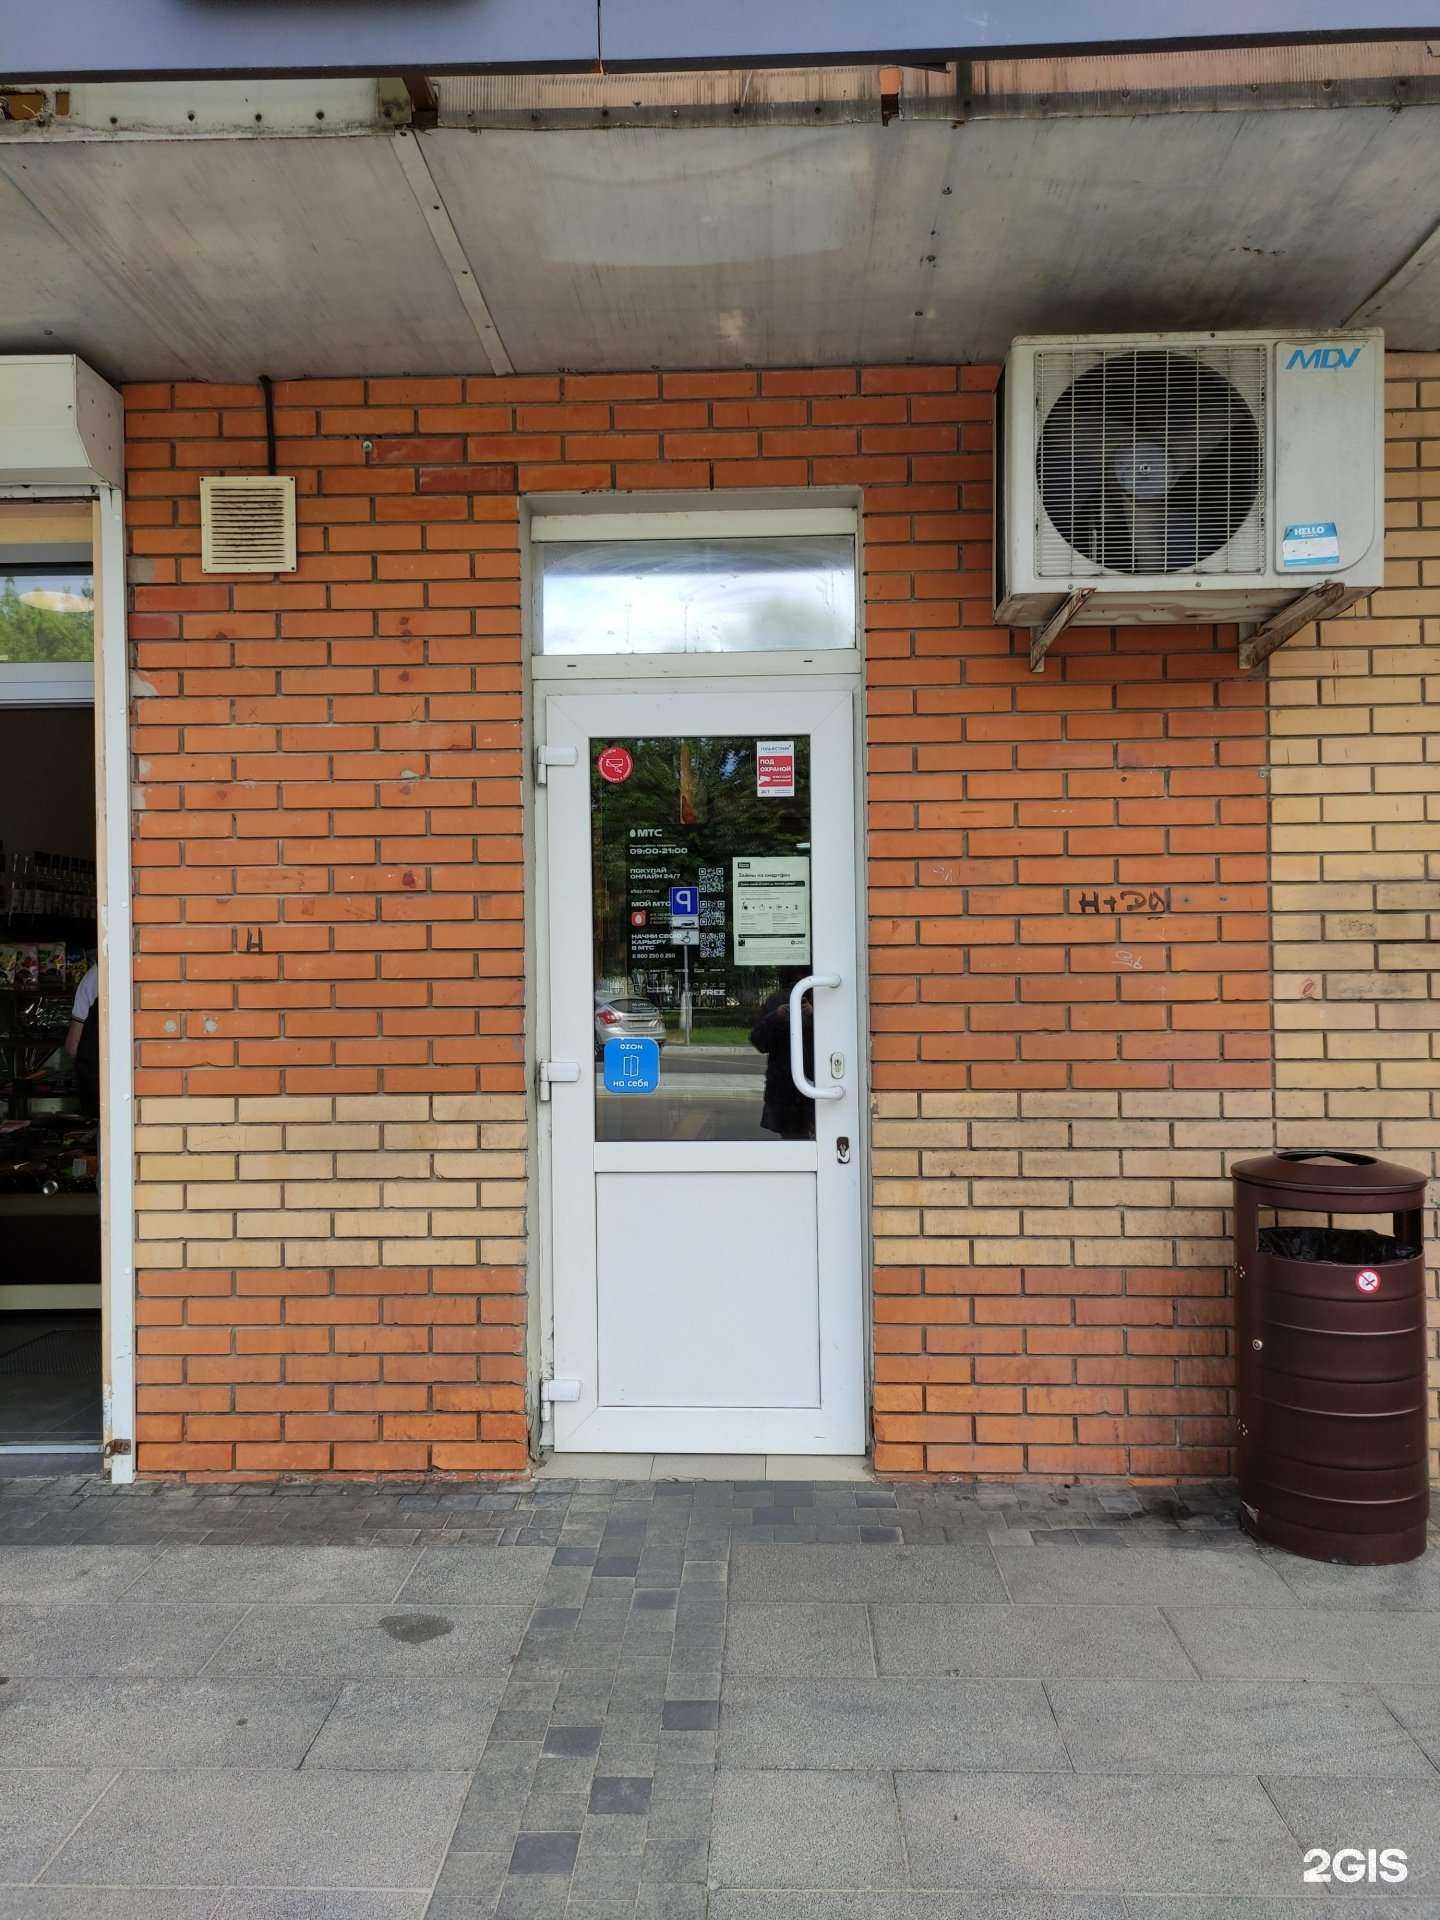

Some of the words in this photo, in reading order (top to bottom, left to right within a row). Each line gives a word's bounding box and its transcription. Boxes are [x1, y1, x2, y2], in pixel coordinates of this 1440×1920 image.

[1285, 348, 1362, 369] MDV
[1294, 526, 1325, 537] HELLO
[637, 829, 663, 838] МТС
[627, 1079, 649, 1087] себя
